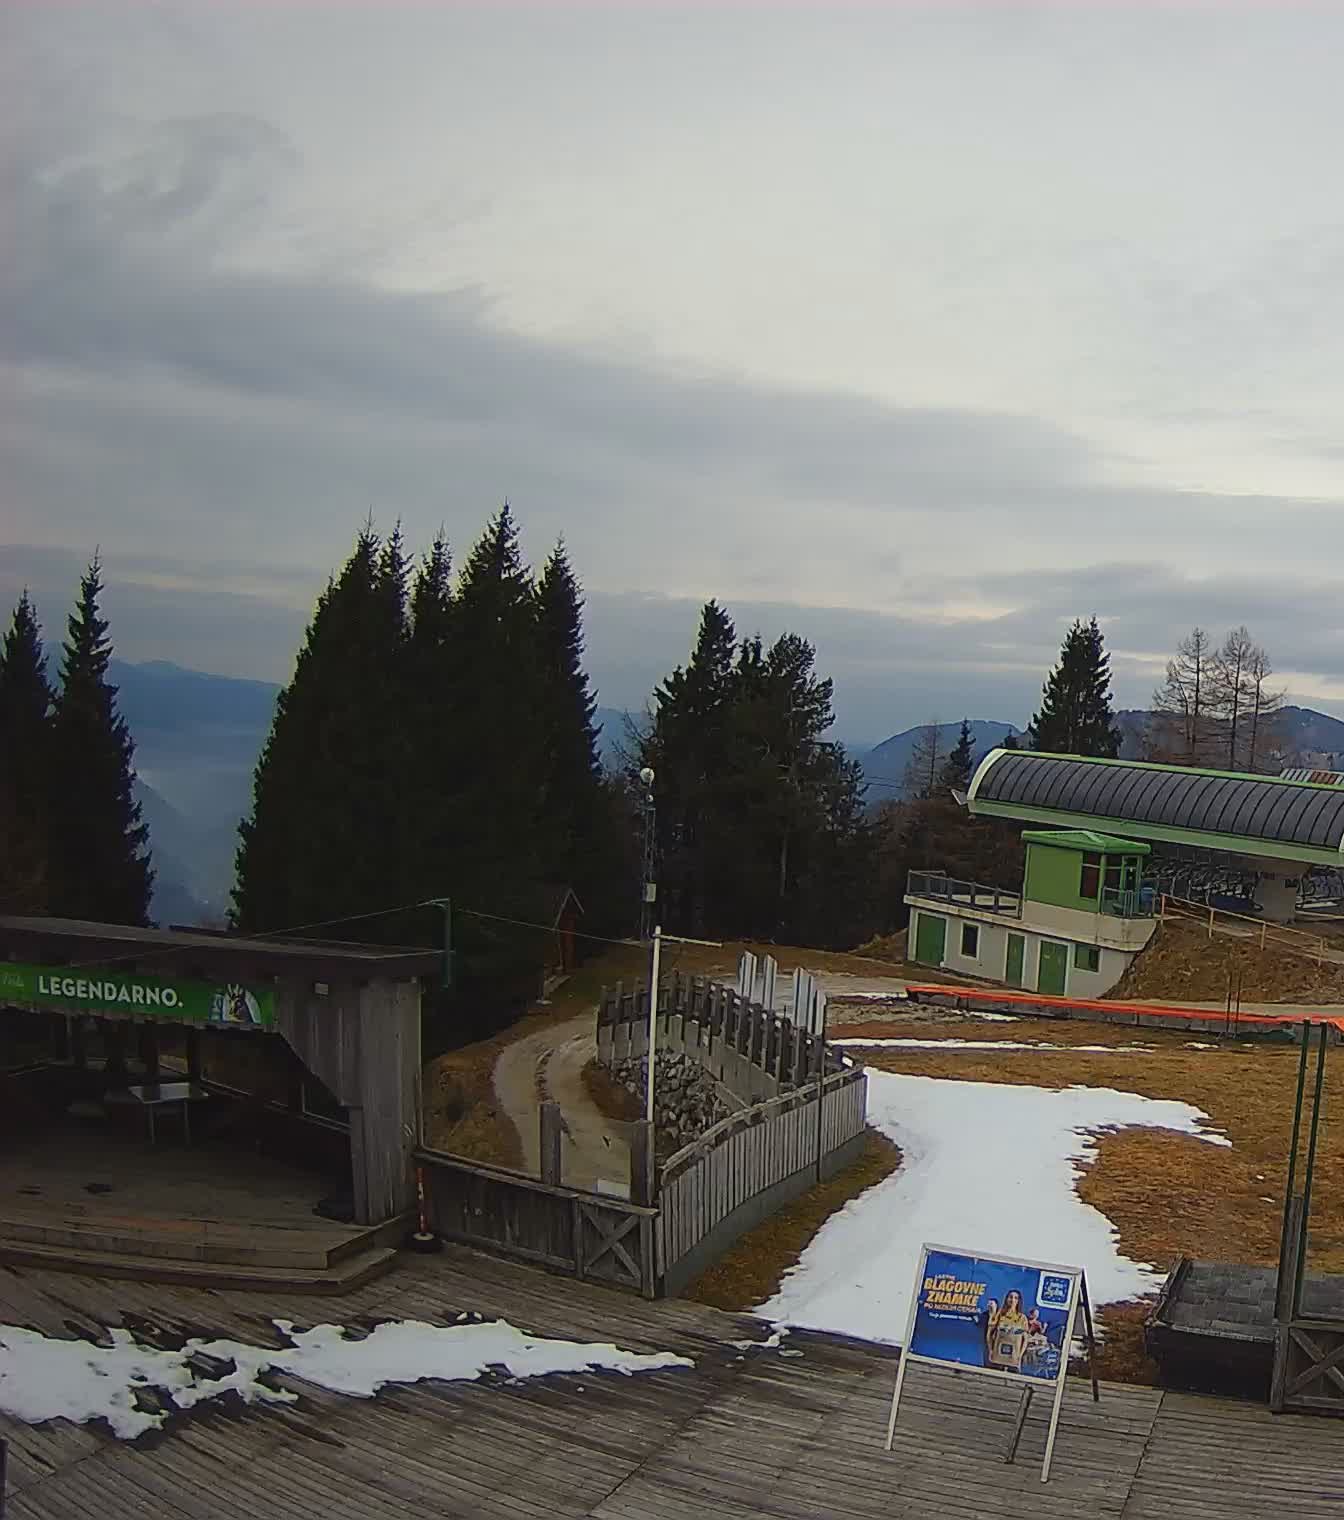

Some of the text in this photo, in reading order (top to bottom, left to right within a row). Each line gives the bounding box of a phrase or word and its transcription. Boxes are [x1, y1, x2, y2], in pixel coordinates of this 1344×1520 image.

[38, 974, 185, 1008] LEGENDARNO.
[924, 1278, 986, 1295] BLAGOVNE
[927, 1290, 979, 1307] ZNAMKE
